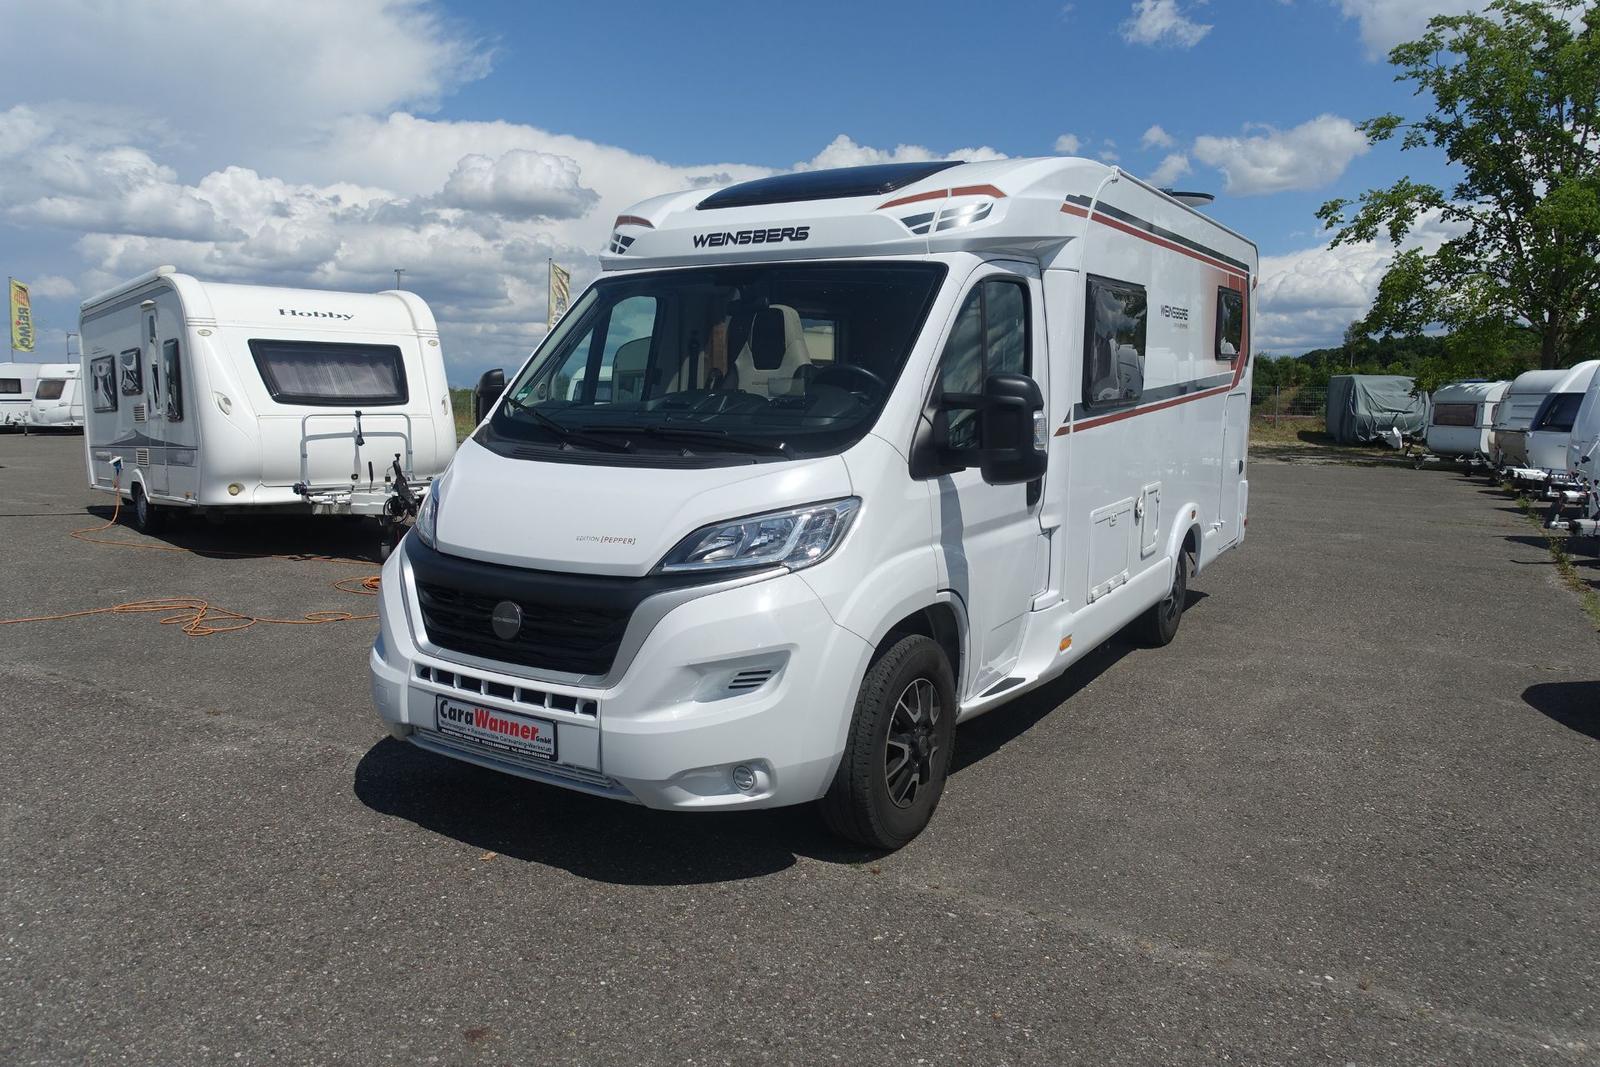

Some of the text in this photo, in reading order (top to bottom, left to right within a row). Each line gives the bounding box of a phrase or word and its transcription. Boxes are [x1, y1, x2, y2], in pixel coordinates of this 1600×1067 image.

[693, 226, 811, 248] WEINSBERG
[278, 308, 354, 320] Hobby
[440, 700, 539, 741] CaraWanner
[536, 735, 552, 744] GmbH
